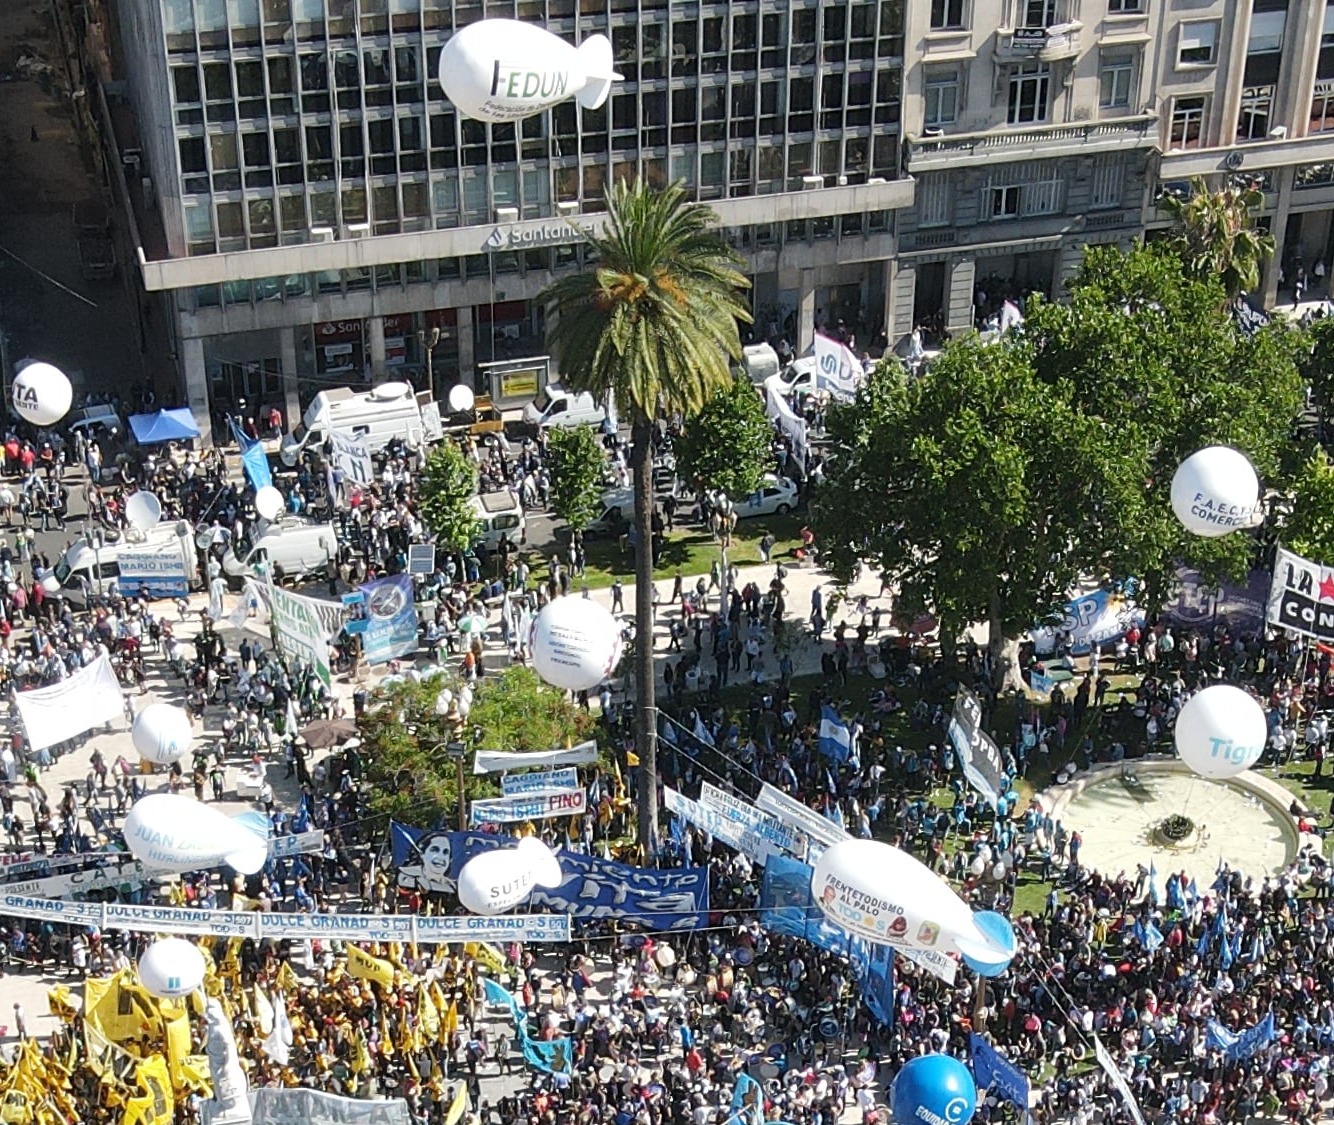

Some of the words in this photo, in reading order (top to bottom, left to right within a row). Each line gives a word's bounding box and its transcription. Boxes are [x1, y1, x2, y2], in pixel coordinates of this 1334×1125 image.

[1285, 561, 1313, 598] LA
[133, 826, 174, 850] JUAN
[824, 874, 905, 916] FRENTETODISMO
[839, 894, 851, 905] AL
[852, 897, 881, 917] PALO
[106, 905, 148, 919] DULCE
[260, 914, 304, 928] DULCE
[417, 916, 461, 929] DULCE
